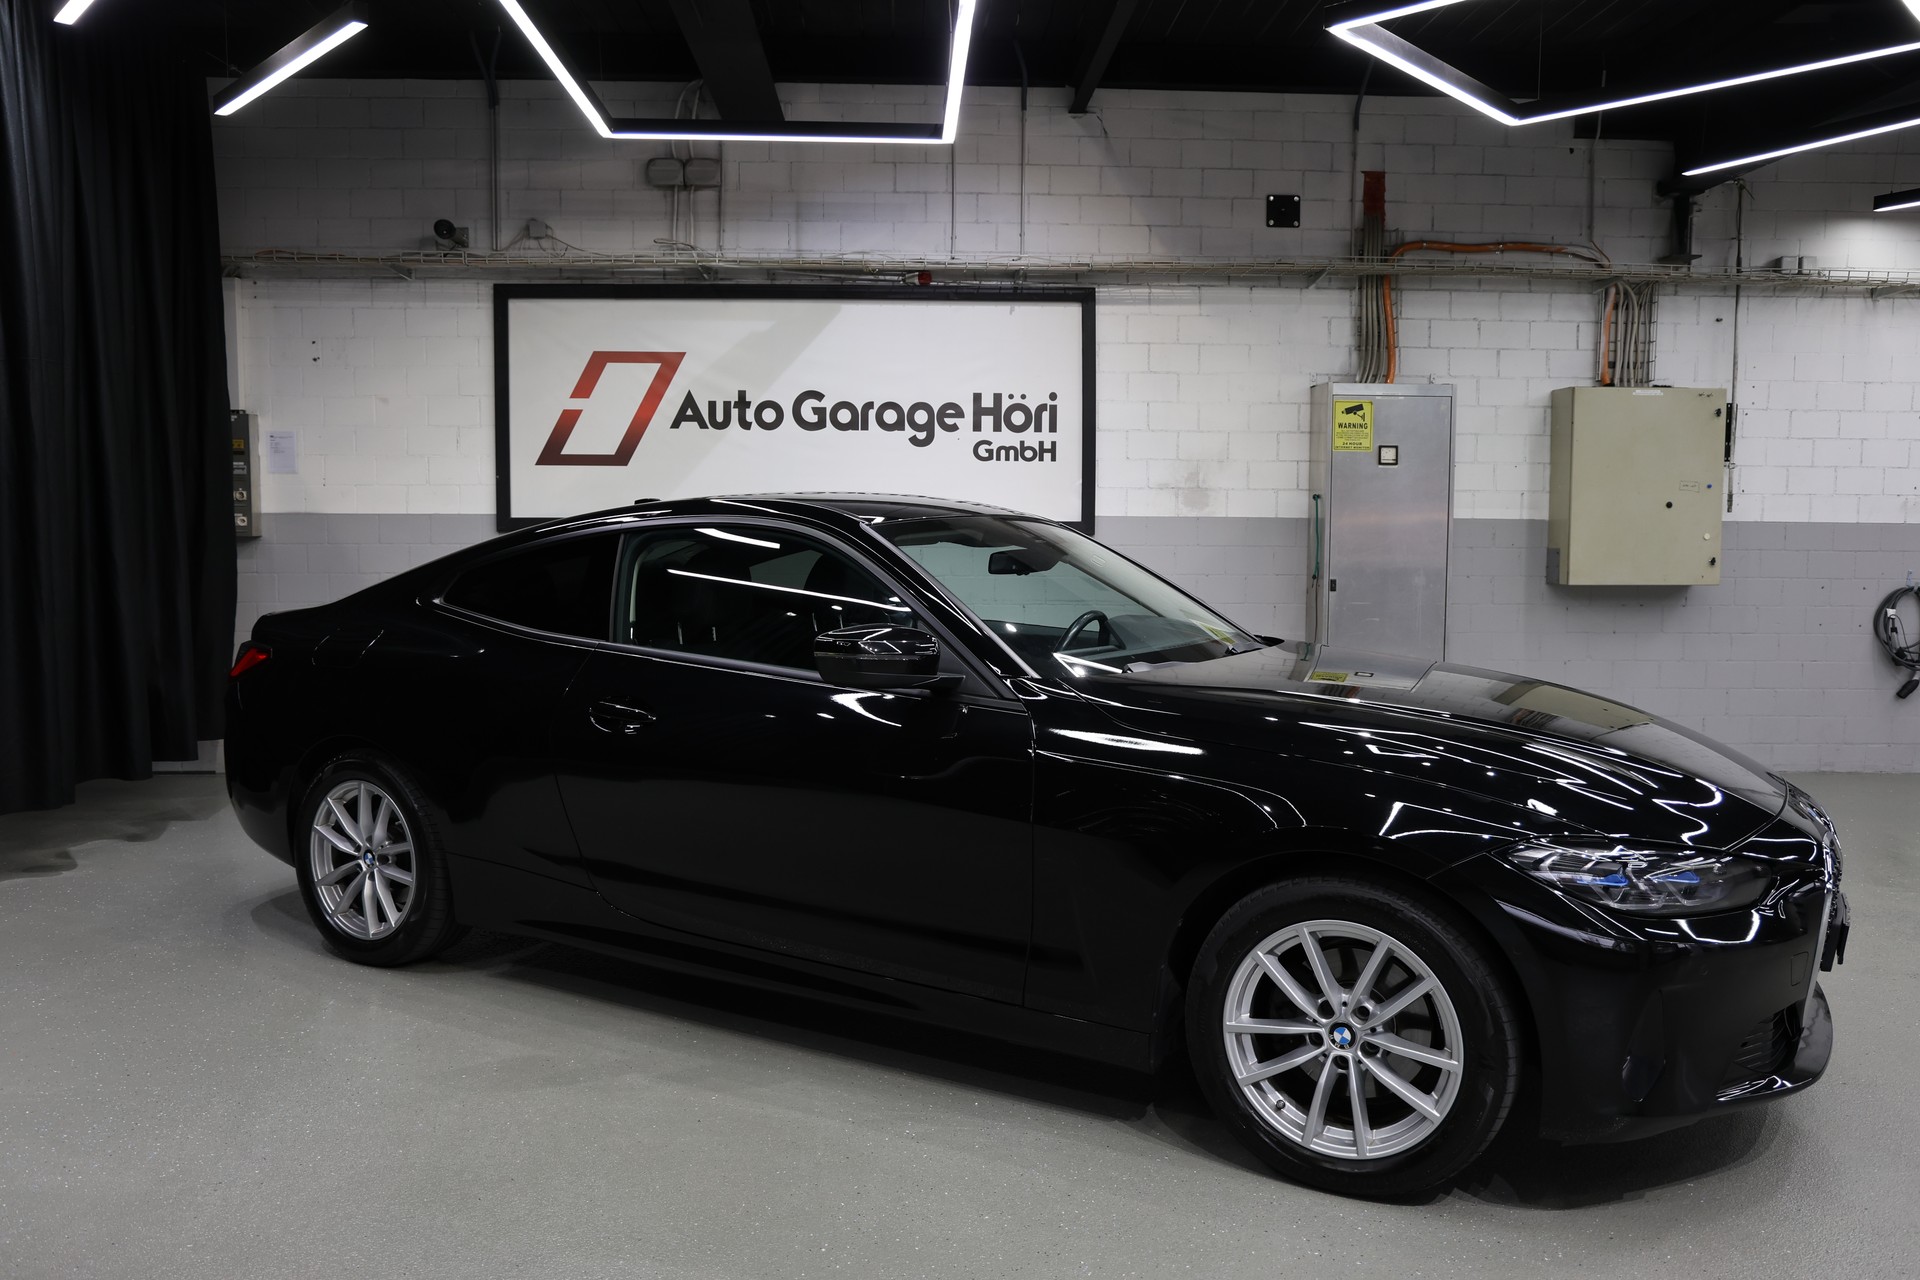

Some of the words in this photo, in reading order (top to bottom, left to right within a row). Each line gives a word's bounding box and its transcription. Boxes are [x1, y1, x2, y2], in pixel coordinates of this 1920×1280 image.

[669, 389, 785, 431] Auto
[792, 389, 965, 448] Garage
[972, 391, 1058, 433] Höri
[972, 439, 1057, 462] GmbH
